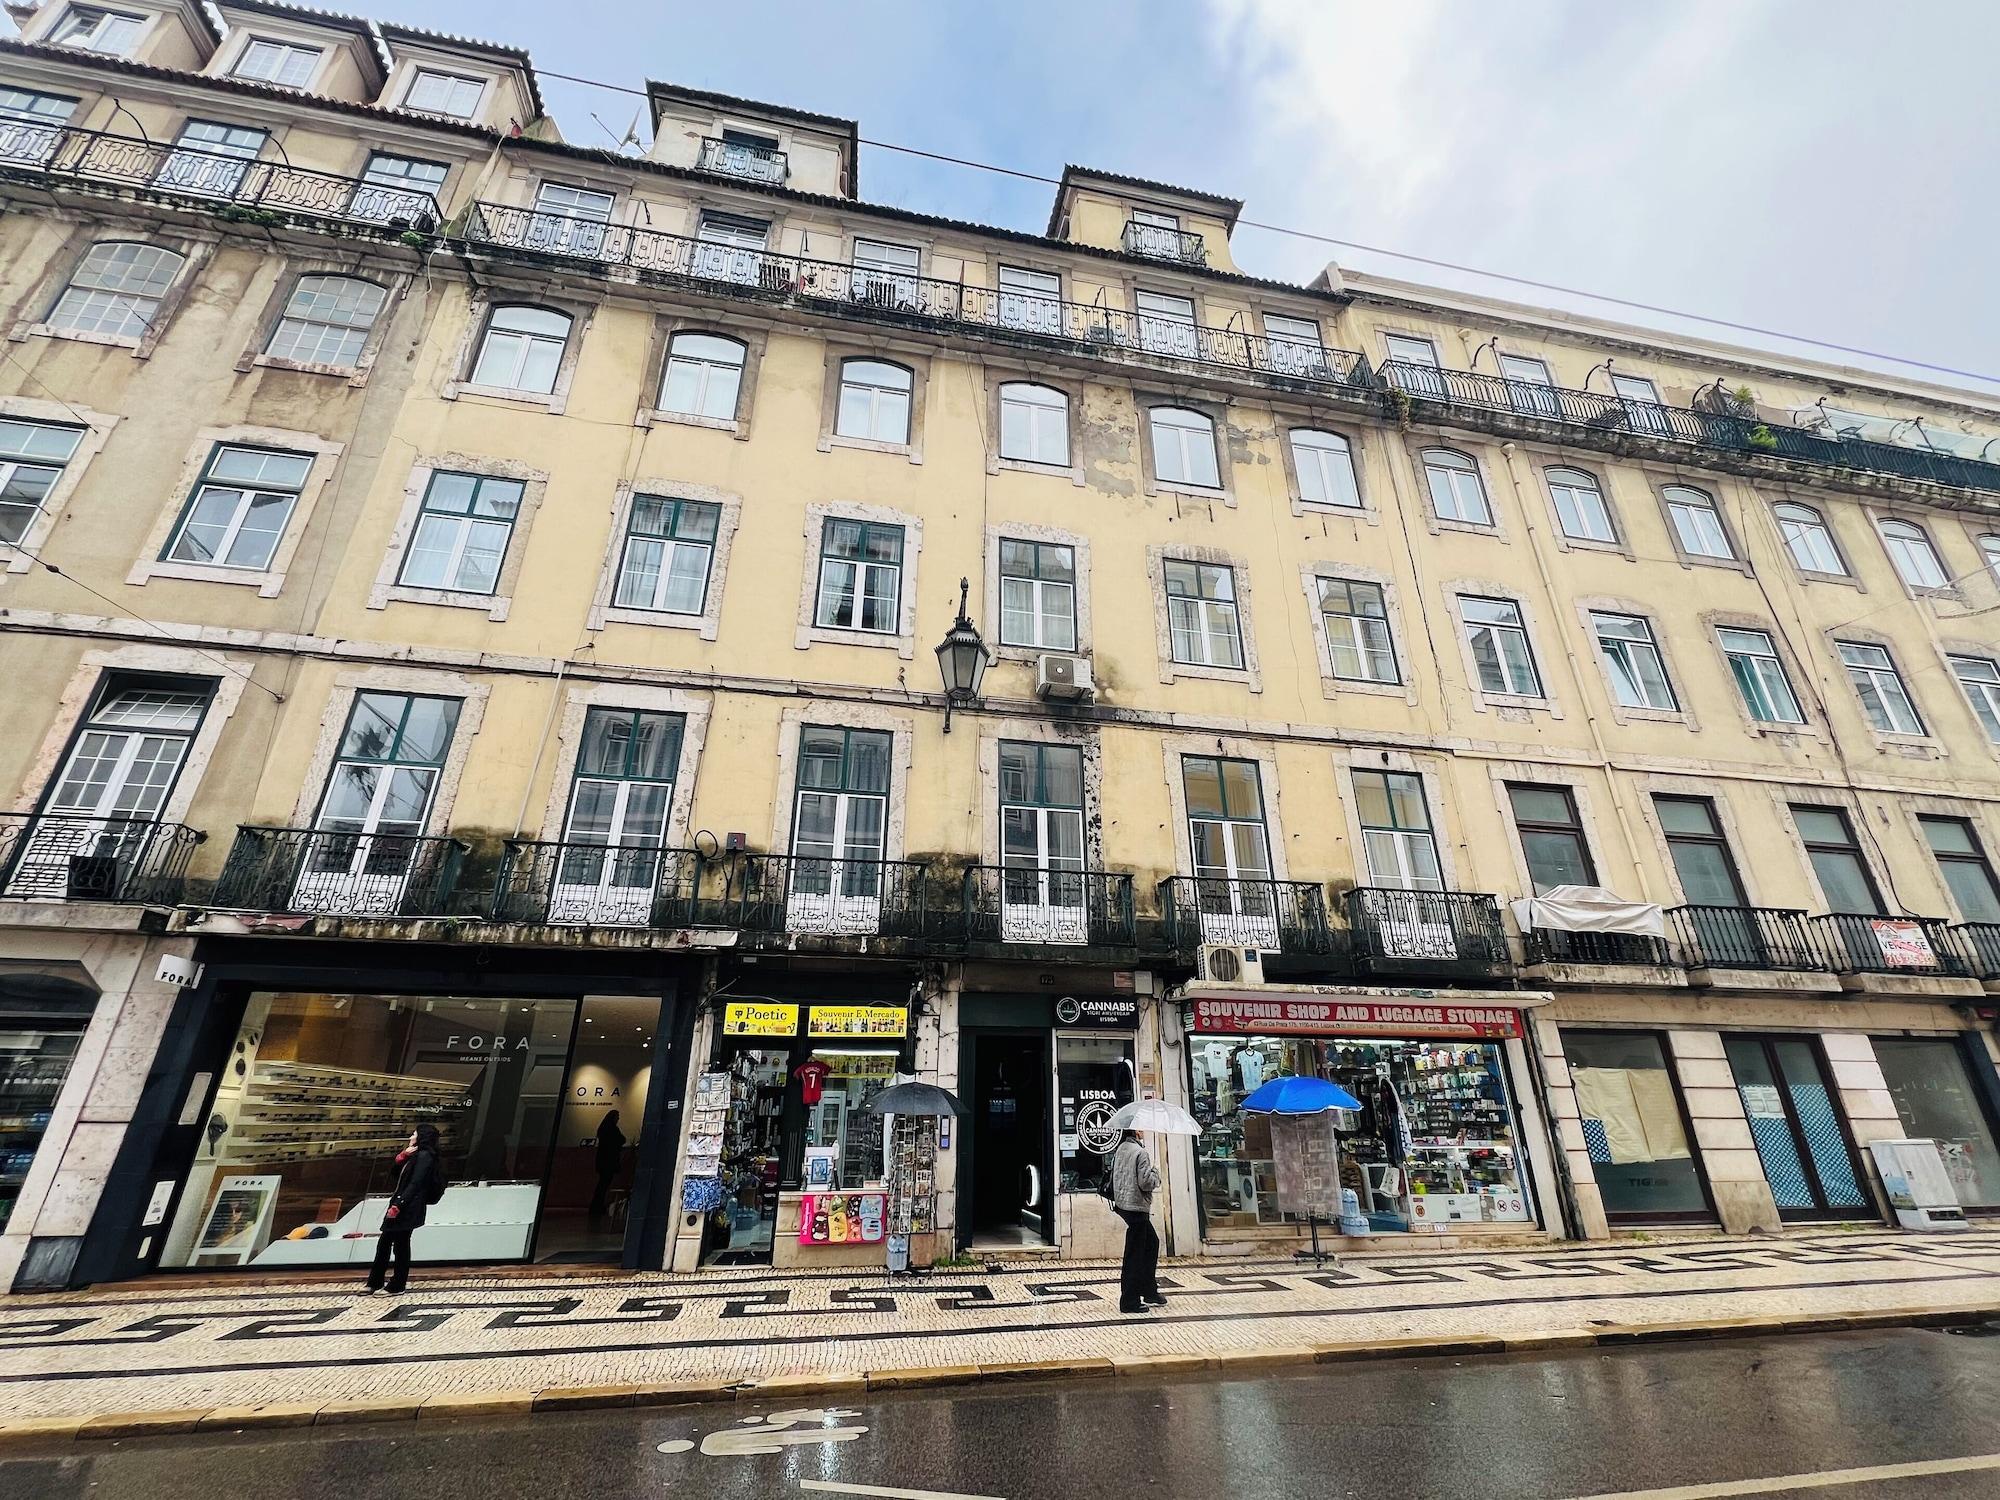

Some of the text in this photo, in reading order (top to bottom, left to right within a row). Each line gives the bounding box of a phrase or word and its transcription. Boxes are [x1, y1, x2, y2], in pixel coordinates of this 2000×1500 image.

[161, 971, 191, 986] FORA
[1080, 1001, 1136, 1012] CANNABIS
[1198, 1001, 1515, 1024] SOUVENIR SHOP AND LUGGAGE STORAGE
[745, 1007, 787, 1021] Poetic
[817, 1009, 900, 1019] Souvenir E Mercado
[446, 1035, 530, 1050] FORA
[809, 1073, 816, 1088] 7
[1080, 1089, 1117, 1100] LISBOA
[1085, 1127, 1114, 1135] CANNABIS
